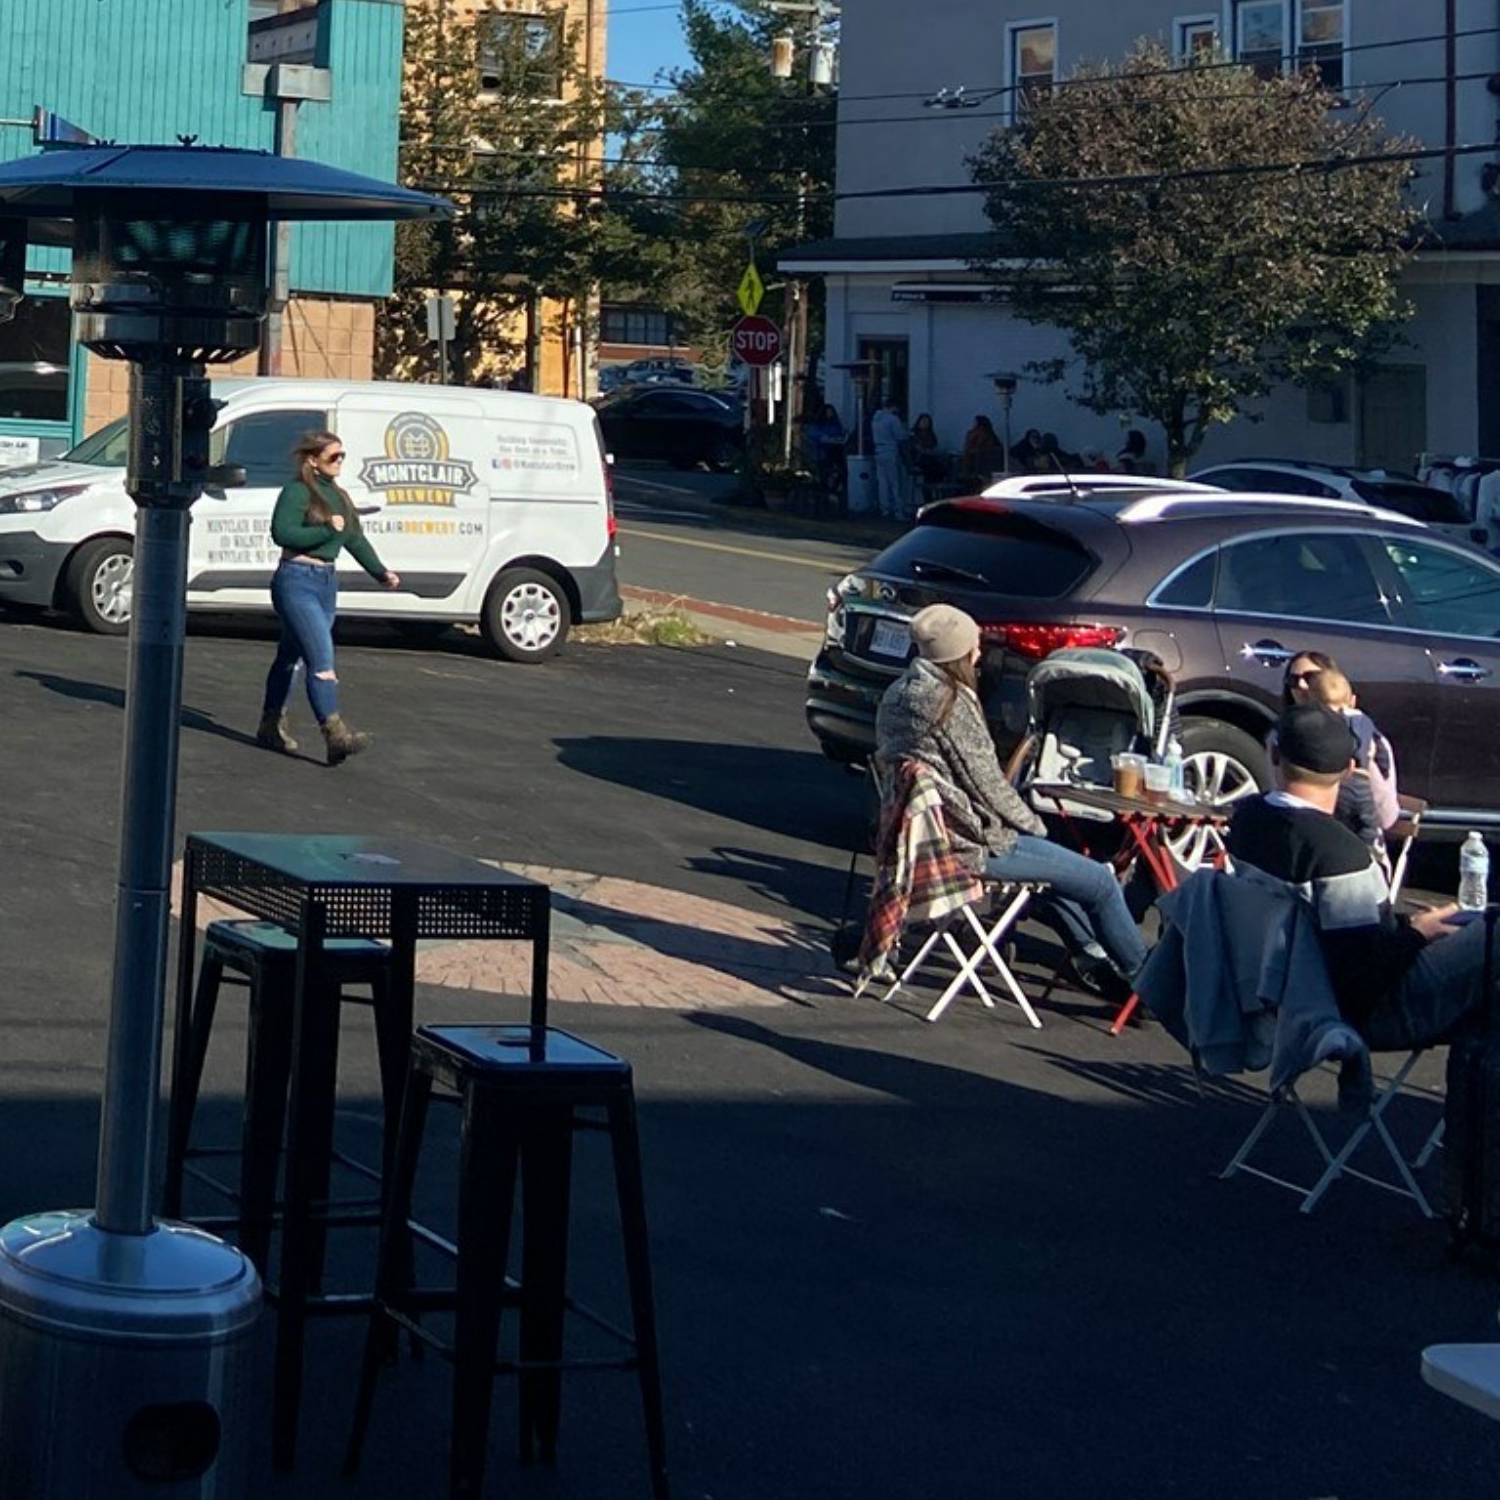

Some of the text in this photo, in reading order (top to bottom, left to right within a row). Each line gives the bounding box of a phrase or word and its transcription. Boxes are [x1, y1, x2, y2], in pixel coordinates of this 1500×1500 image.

[736, 331, 778, 350] STOP
[373, 464, 464, 485] MONTCLAIR
[388, 489, 453, 504] BREWERY
